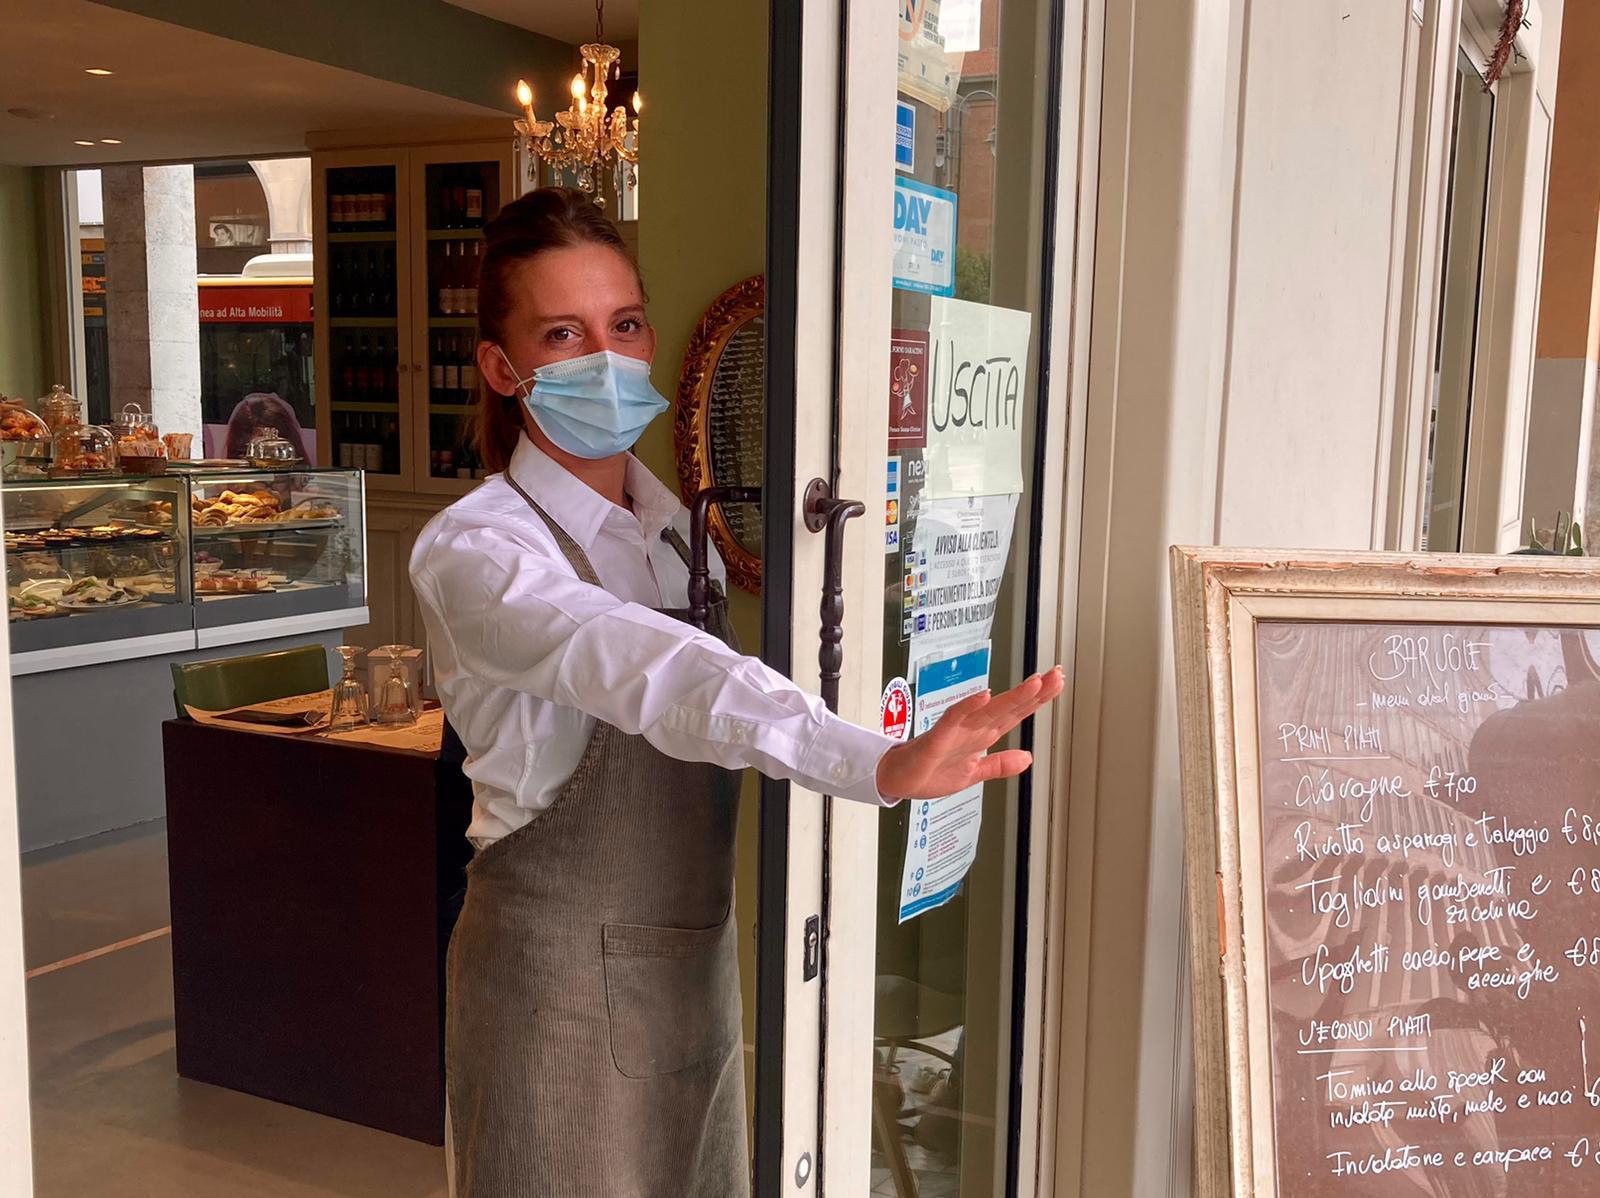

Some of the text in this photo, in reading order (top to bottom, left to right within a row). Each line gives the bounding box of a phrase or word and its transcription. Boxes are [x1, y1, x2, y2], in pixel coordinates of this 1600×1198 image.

[216, 307, 227, 317] ad
[229, 307, 246, 318] Alta
[248, 306, 283, 317] Mobilità
[932, 338, 1019, 432] USCITA
[934, 534, 957, 556] AVVISO
[957, 532, 972, 553] ALLA
[1369, 633, 1494, 690] BAR SOLE
[1278, 722, 1383, 753] PRIMI PIATTI
[1294, 820, 1364, 861] Risotto
[1377, 822, 1458, 867] asparagi
[1465, 832, 1479, 847] e
[1474, 812, 1550, 856] taleggio
[1531, 873, 1552, 895] e
[1302, 942, 1389, 994] Spaghetti
[1517, 942, 1535, 962] e
[1299, 1013, 1432, 1046] SECONDI PIATTI
[1316, 1069, 1394, 1102] Tomino
[1399, 1068, 1437, 1092] allo
[1517, 1069, 1546, 1085] con
[1465, 1090, 1507, 1116] mele
[1518, 1096, 1531, 1108] e
[1454, 1152, 1466, 1166] e
